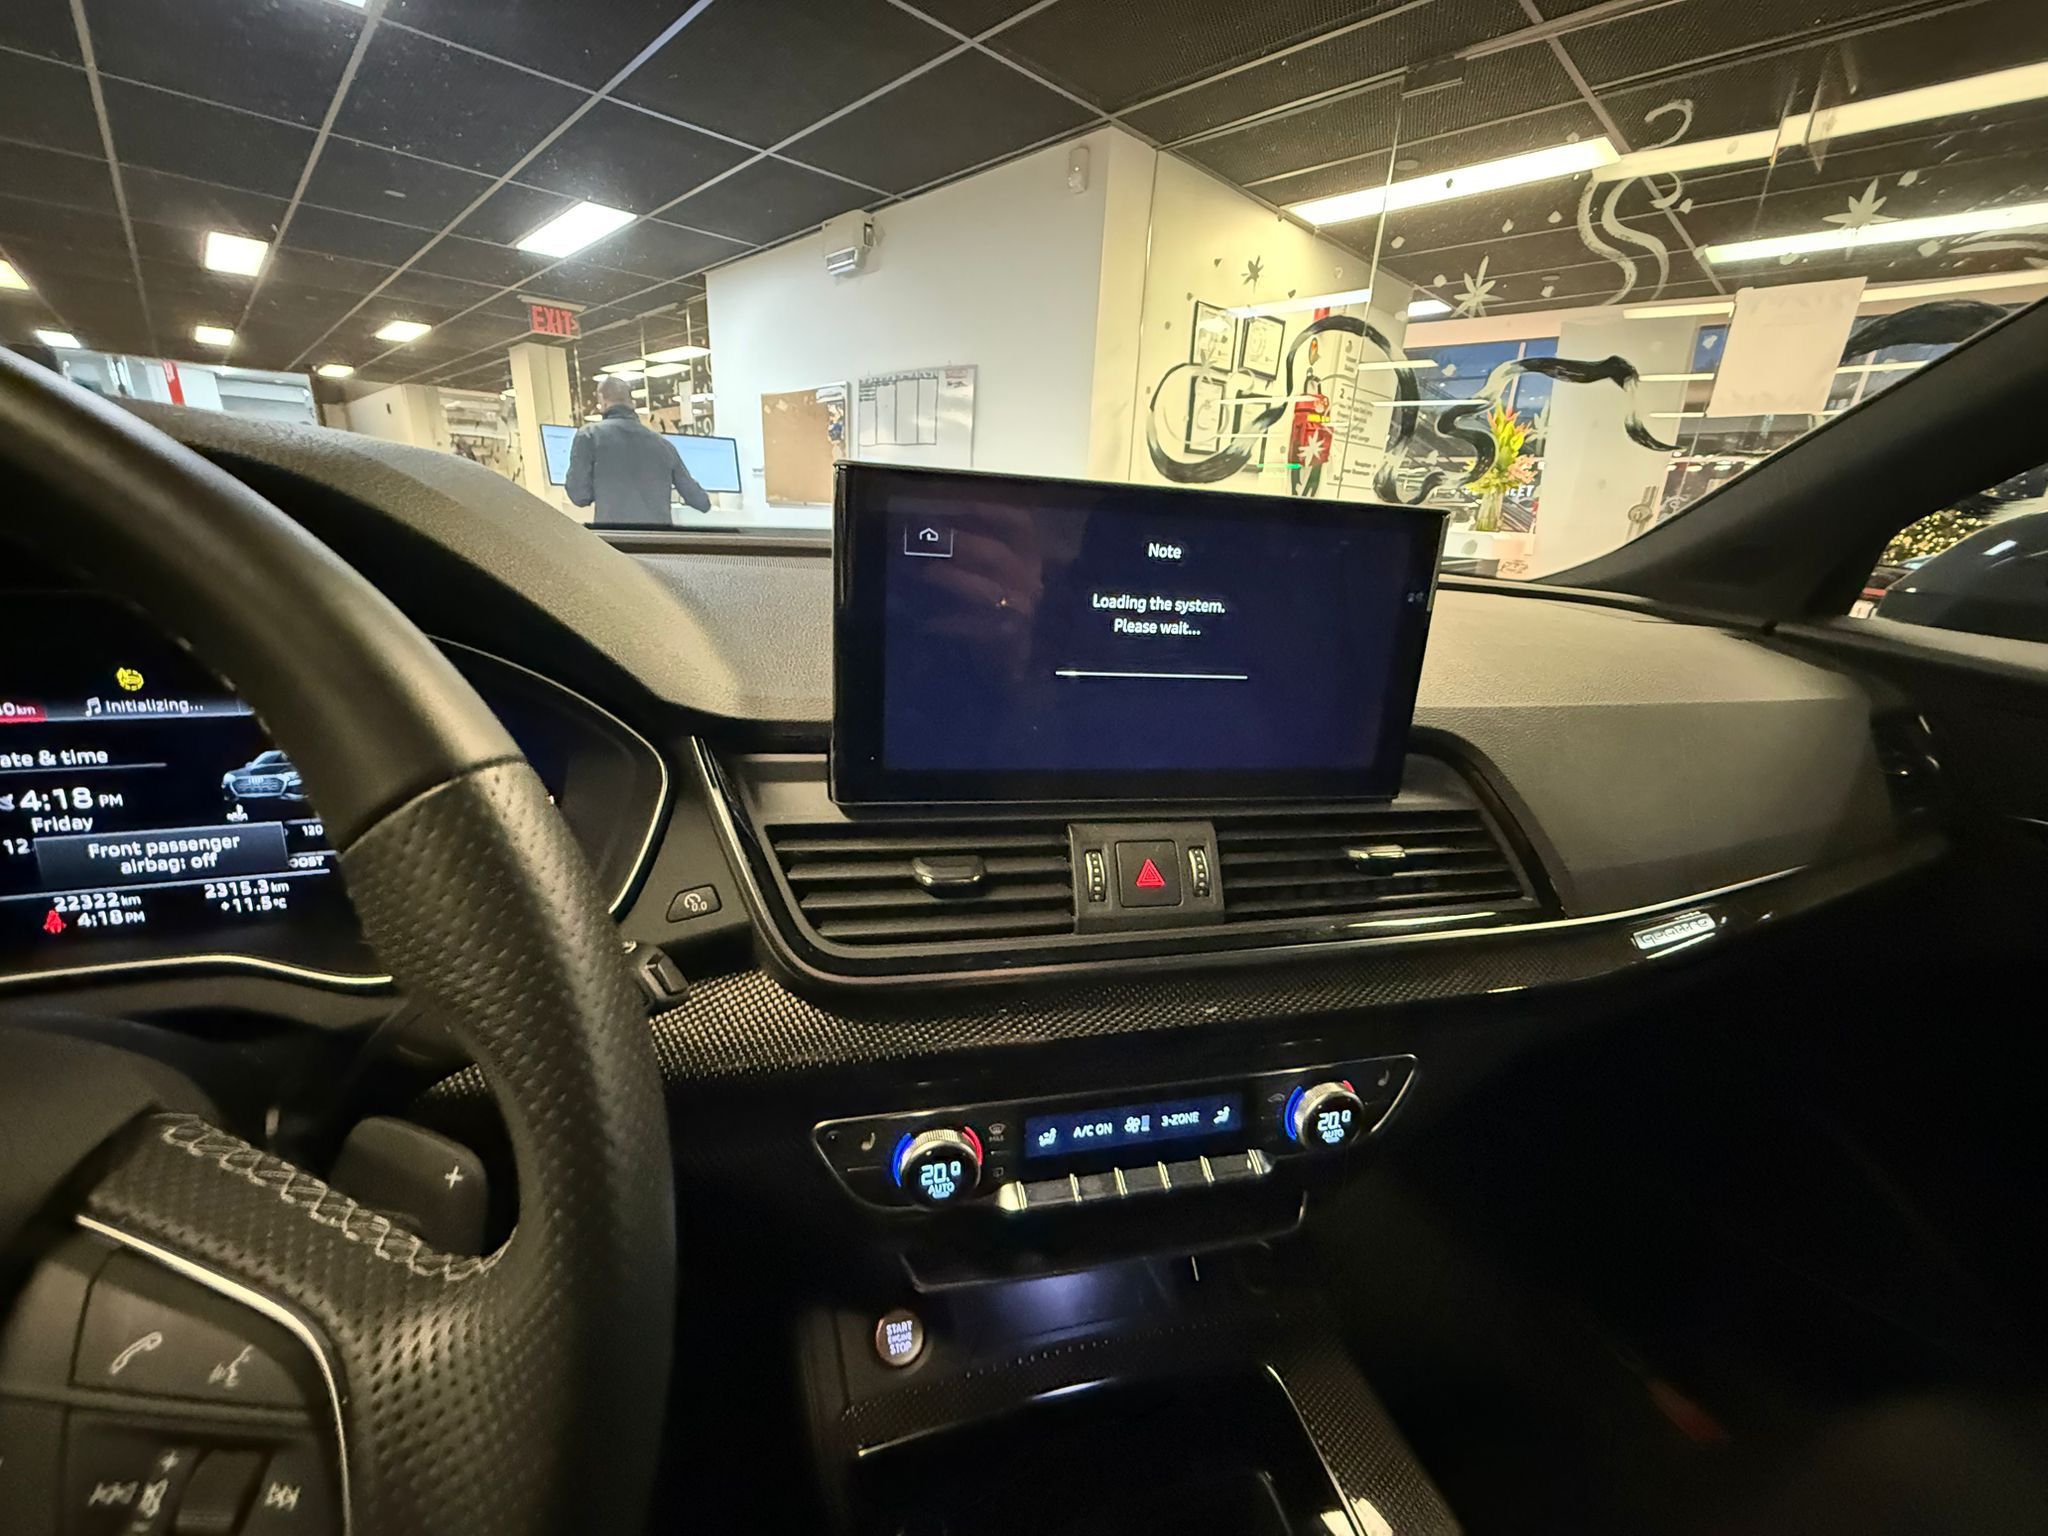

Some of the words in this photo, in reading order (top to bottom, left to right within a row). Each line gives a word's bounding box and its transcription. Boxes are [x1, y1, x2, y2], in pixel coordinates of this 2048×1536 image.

[531, 305, 572, 336] EXIT
[1148, 542, 1182, 559] Note
[1092, 593, 1147, 614] Loading
[1149, 596, 1173, 611] the
[1174, 599, 1226, 615] system.
[1114, 618, 1158, 634] Please
[1160, 621, 1201, 635] wait...
[0, 702, 37, 716] 0km
[106, 699, 204, 714] Initializing...
[38, 749, 57, 767] &
[61, 749, 109, 765] time
[20, 786, 94, 812] 4:18
[98, 793, 124, 808] PM
[30, 815, 93, 833] Friday
[88, 841, 142, 859] Front
[146, 836, 240, 857] passenger
[120, 856, 186, 875] airbag:
[190, 851, 218, 869] off
[1161, 1111, 1200, 1127] 3-ZONE
[1073, 1125, 1094, 1139] A/C
[1096, 1122, 1113, 1135] ON
[1322, 1128, 1345, 1139] AUTO
[928, 1181, 955, 1195] AUTO
[886, 1320, 913, 1337] START
[890, 1340, 912, 1356] STOP
